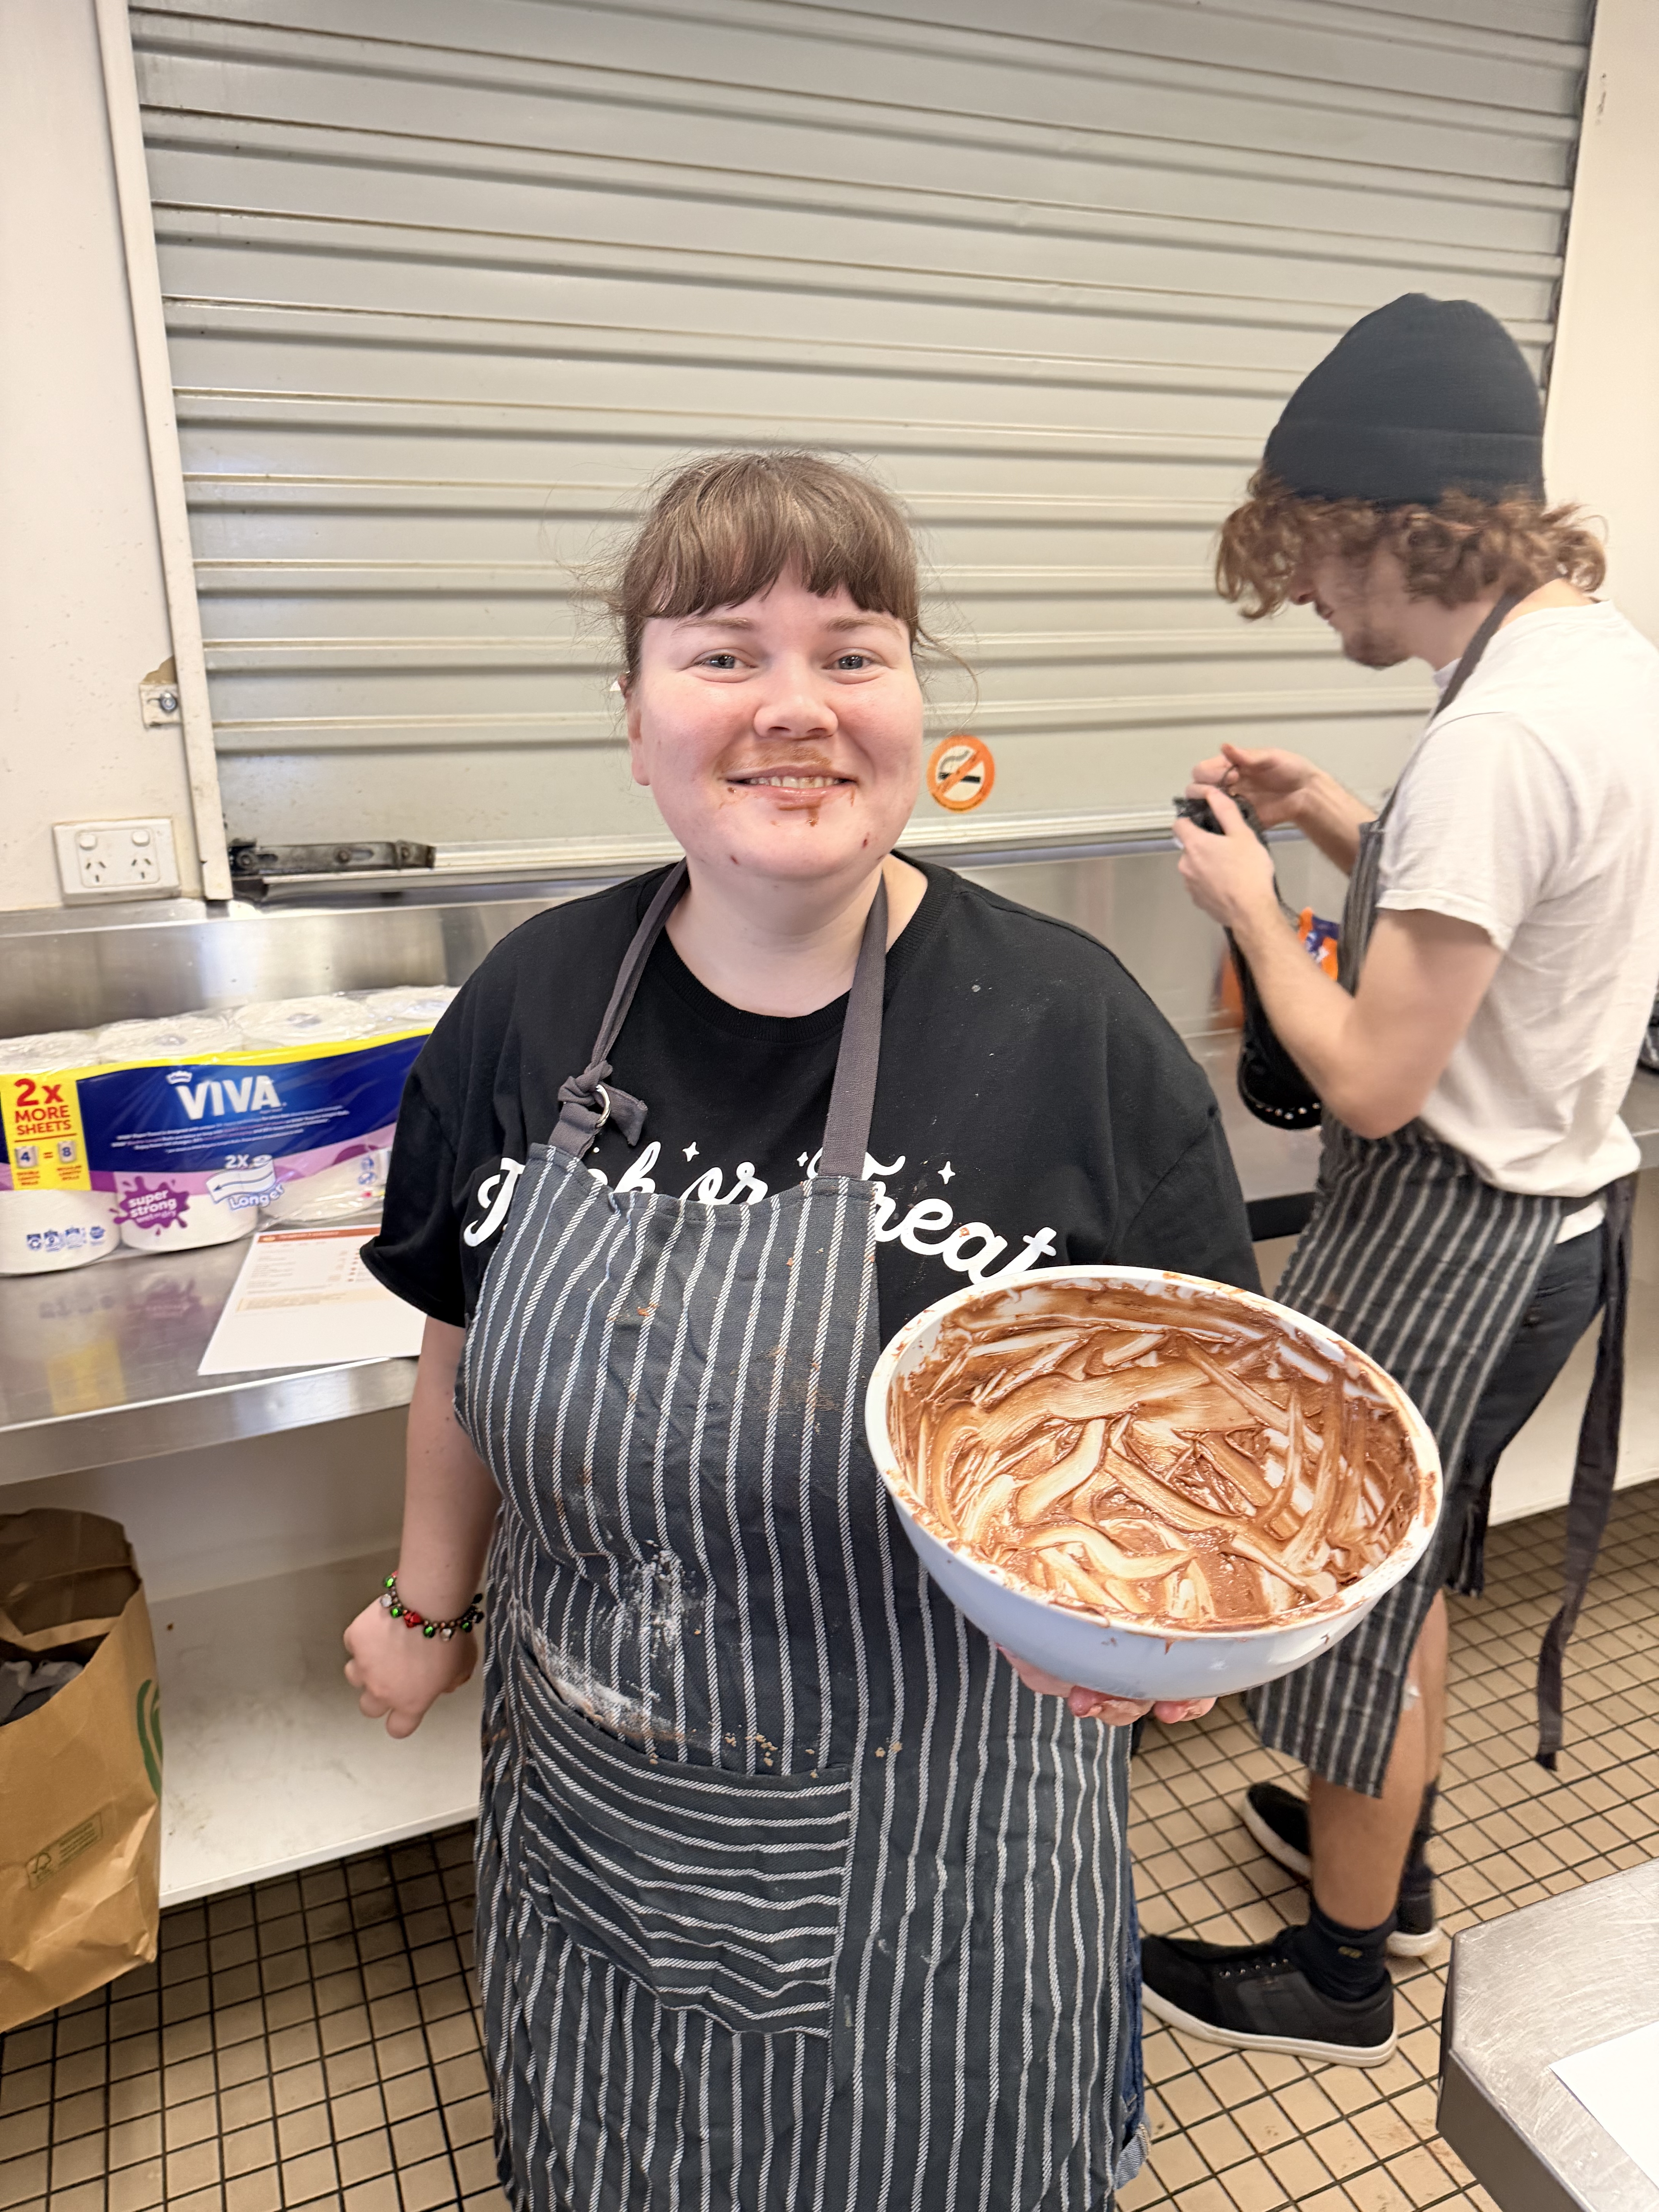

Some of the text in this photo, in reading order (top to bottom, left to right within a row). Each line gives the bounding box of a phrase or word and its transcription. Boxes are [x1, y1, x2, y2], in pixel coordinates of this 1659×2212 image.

[14, 1078, 64, 1107] 2x
[175, 1075, 282, 1120] VIVA
[15, 1105, 70, 1123] MORE
[17, 1120, 71, 1135] SHEETS
[21, 1152, 31, 1162] 4
[62, 1147, 72, 1157] 8
[225, 1154, 249, 1169] 2X
[678, 1162, 768, 1205] or
[128, 1190, 168, 1208] super
[229, 1184, 283, 1208] Longer
[130, 1198, 177, 1218] strong
